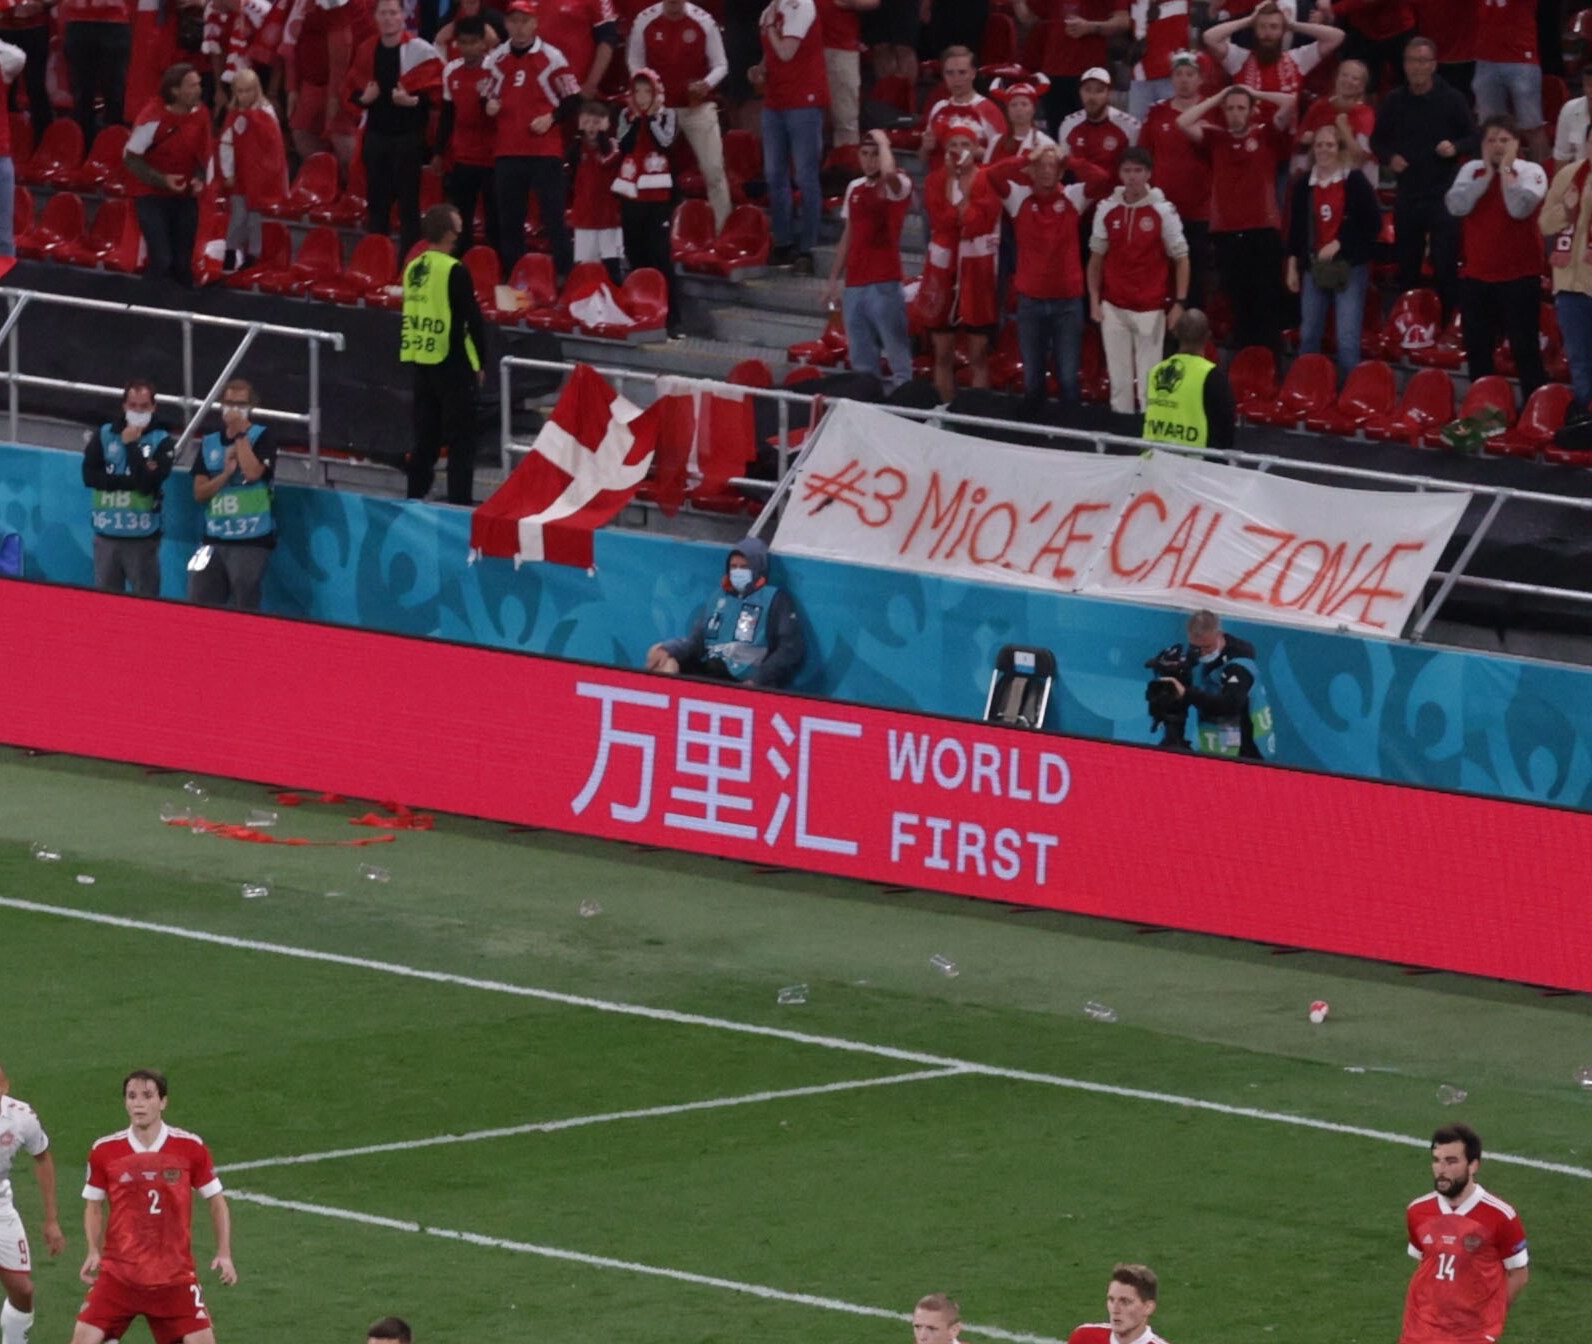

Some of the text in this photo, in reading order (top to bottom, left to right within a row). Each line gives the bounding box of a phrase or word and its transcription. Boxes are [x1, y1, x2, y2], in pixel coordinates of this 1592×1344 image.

[1320, 203, 1333, 222] 9
[102, 491, 132, 507] HB
[211, 495, 239, 514] HB
[802, 459, 908, 527] #3
[570, 682, 862, 855] 万里汇
[887, 729, 1071, 804] WORLD
[890, 812, 1060, 885] FIRST
[147, 1188, 162, 1215] 2
[17, 1239, 29, 1266] 9
[1435, 1253, 1457, 1281] 14
[189, 1284, 204, 1308] 2
